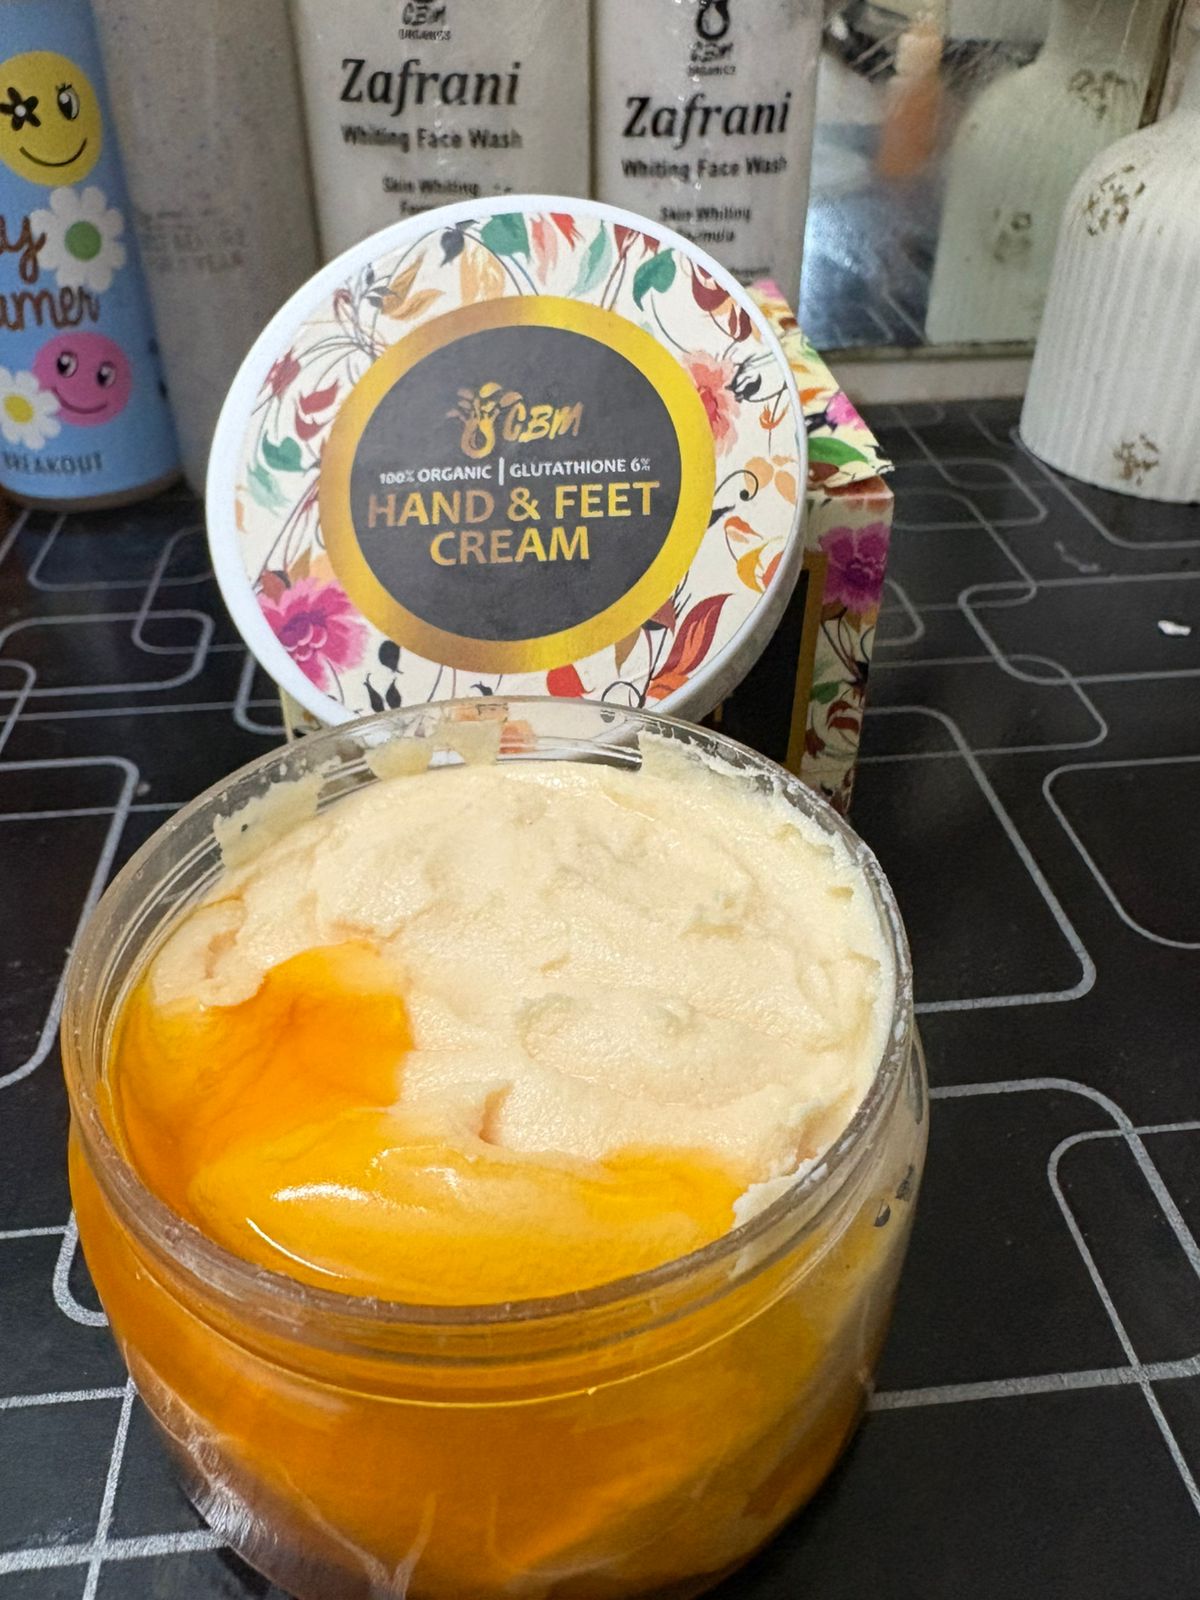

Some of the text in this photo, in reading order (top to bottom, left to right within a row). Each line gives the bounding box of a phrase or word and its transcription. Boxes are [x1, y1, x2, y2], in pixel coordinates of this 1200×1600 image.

[340, 58, 521, 117] Zafrani
[417, 128, 463, 149] Face
[468, 127, 523, 149] Wash
[622, 91, 793, 150] Zafrani
[697, 158, 740, 178] Face
[745, 155, 788, 175] Wash
[502, 401, 584, 443] CBM
[379, 457, 651, 485] 100% ORGANIC GLUTATHIONE 6%
[367, 481, 660, 528] HAND & FEET
[430, 525, 590, 566] CREAM
